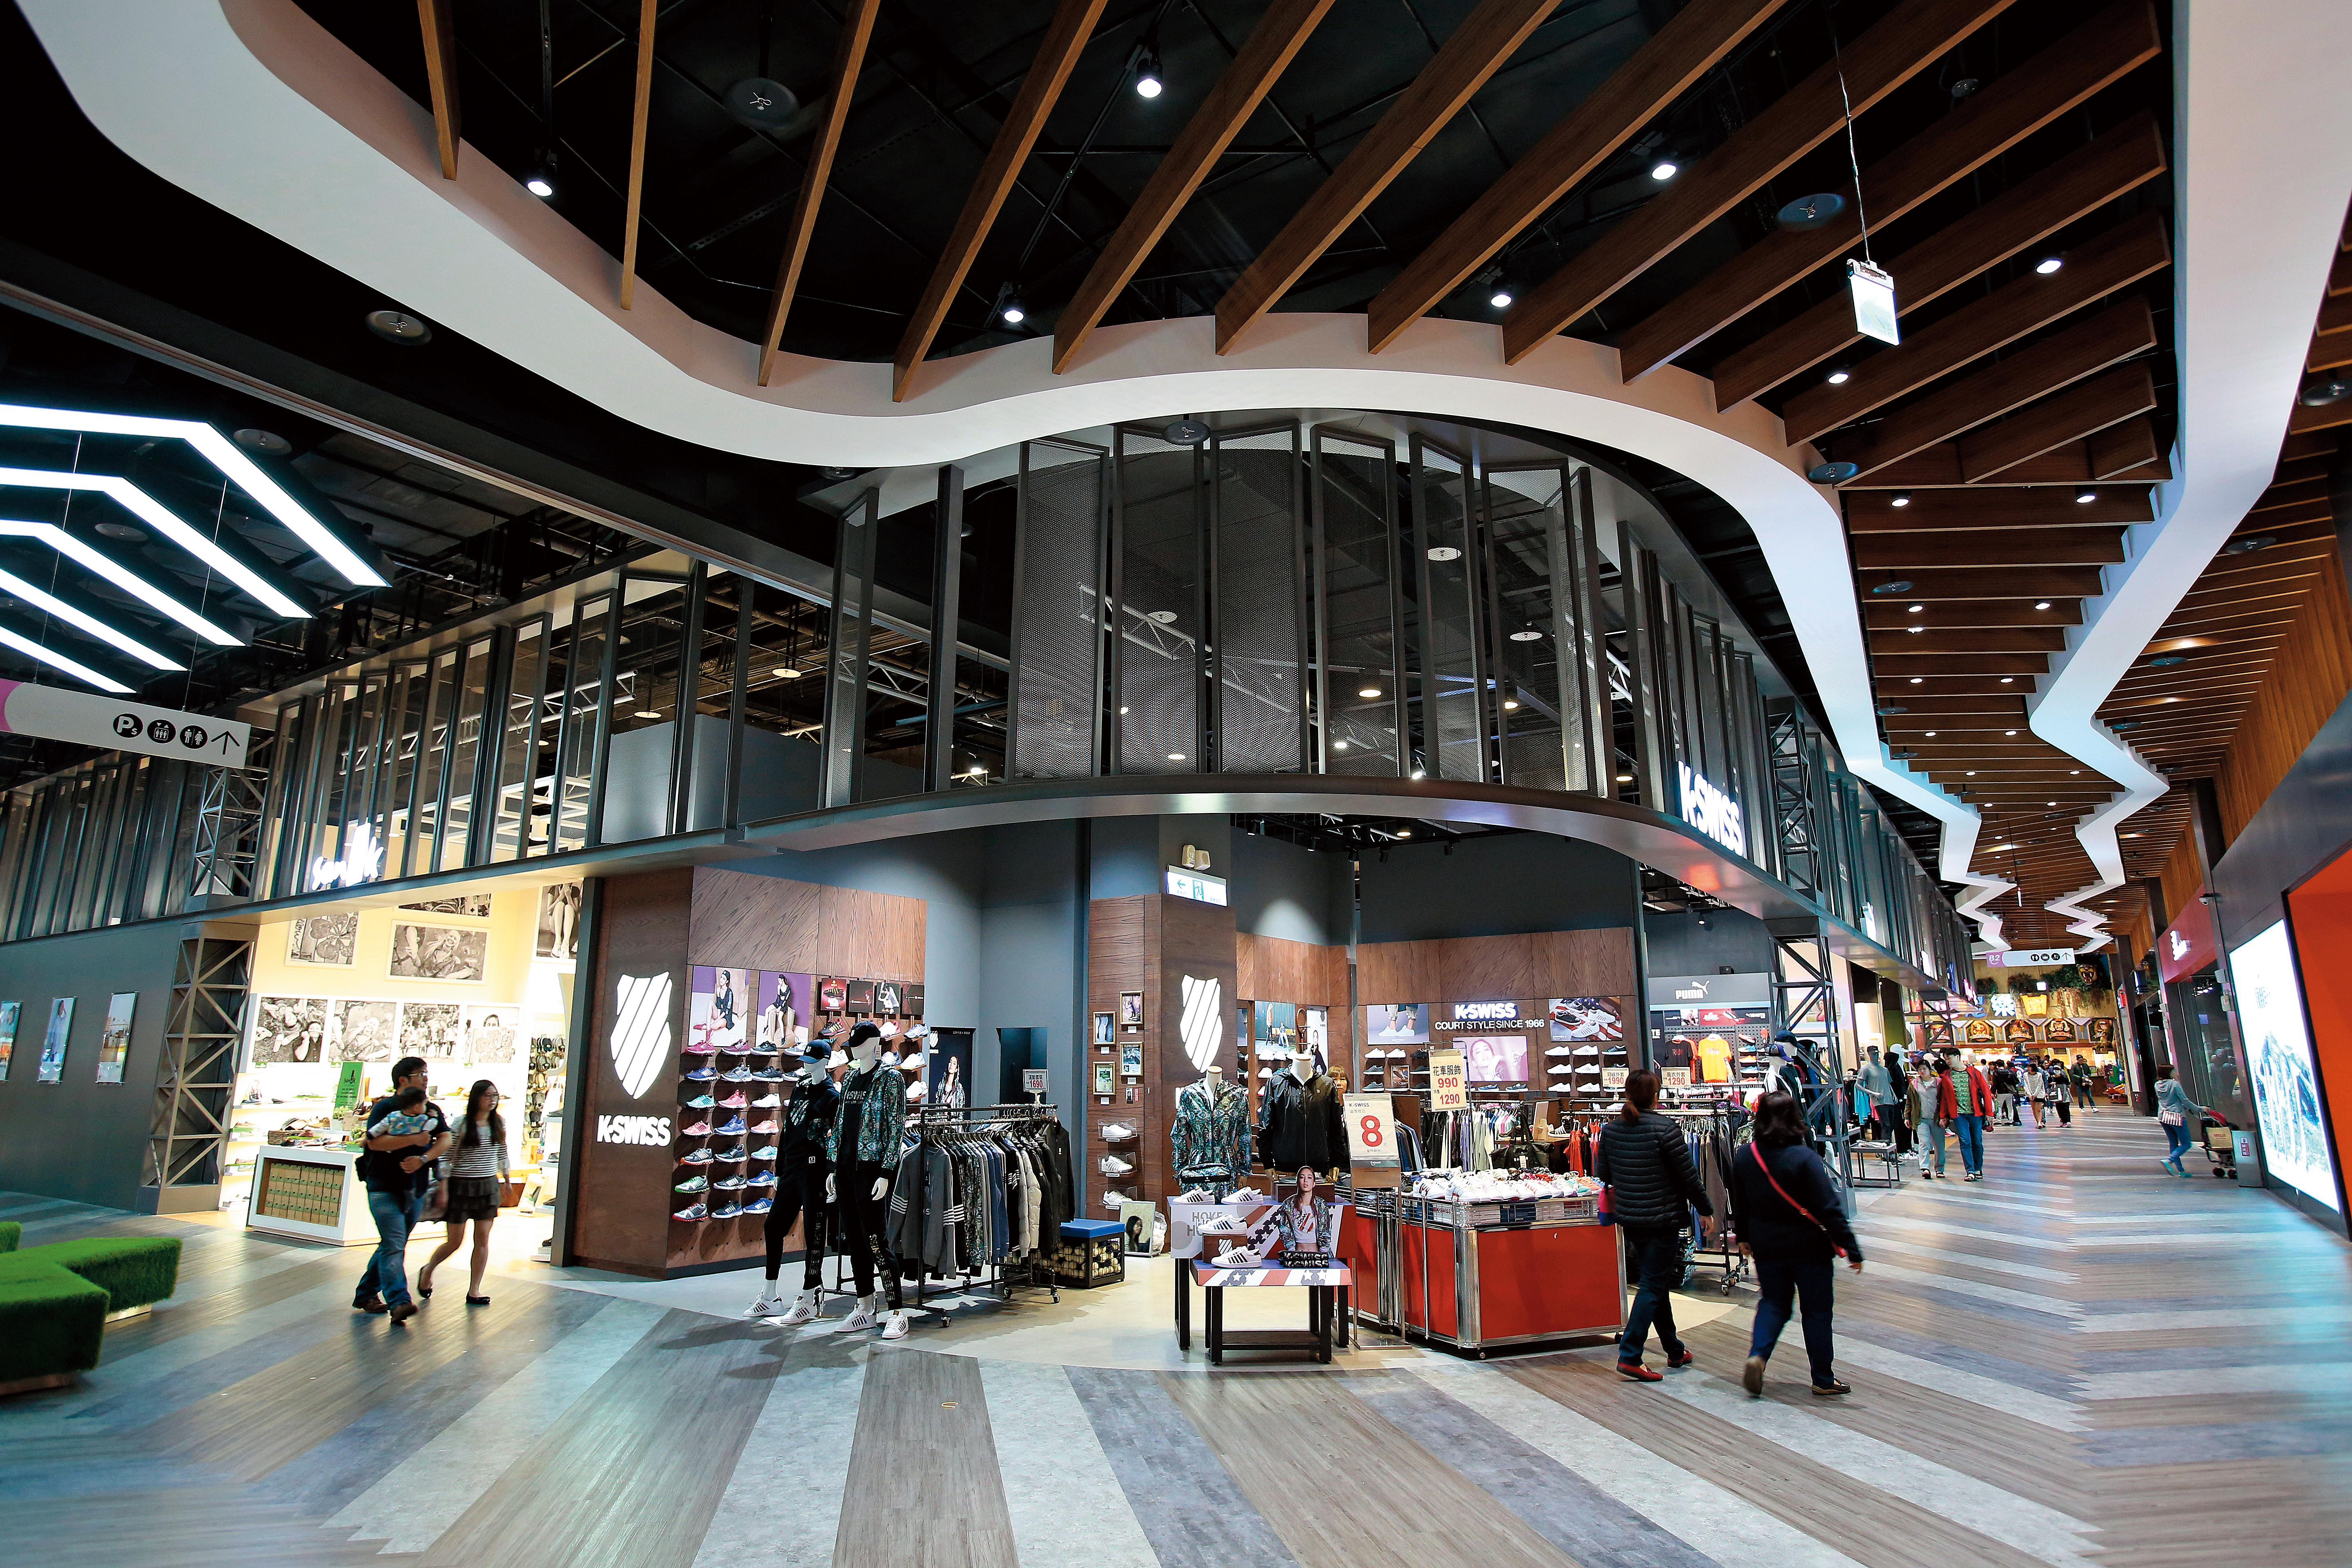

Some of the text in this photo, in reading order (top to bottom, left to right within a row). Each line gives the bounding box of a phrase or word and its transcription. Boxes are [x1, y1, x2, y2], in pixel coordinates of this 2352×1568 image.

[1675, 989, 1703, 999] PUMA
[1435, 1019, 1545, 1030] COURT STYLE SINCE 1966
[1432, 1065, 1461, 1076] 花車服飾
[1438, 1077, 1458, 1088] 990
[1440, 1094, 1460, 1105] 1290
[1361, 1115, 1383, 1147] 8
